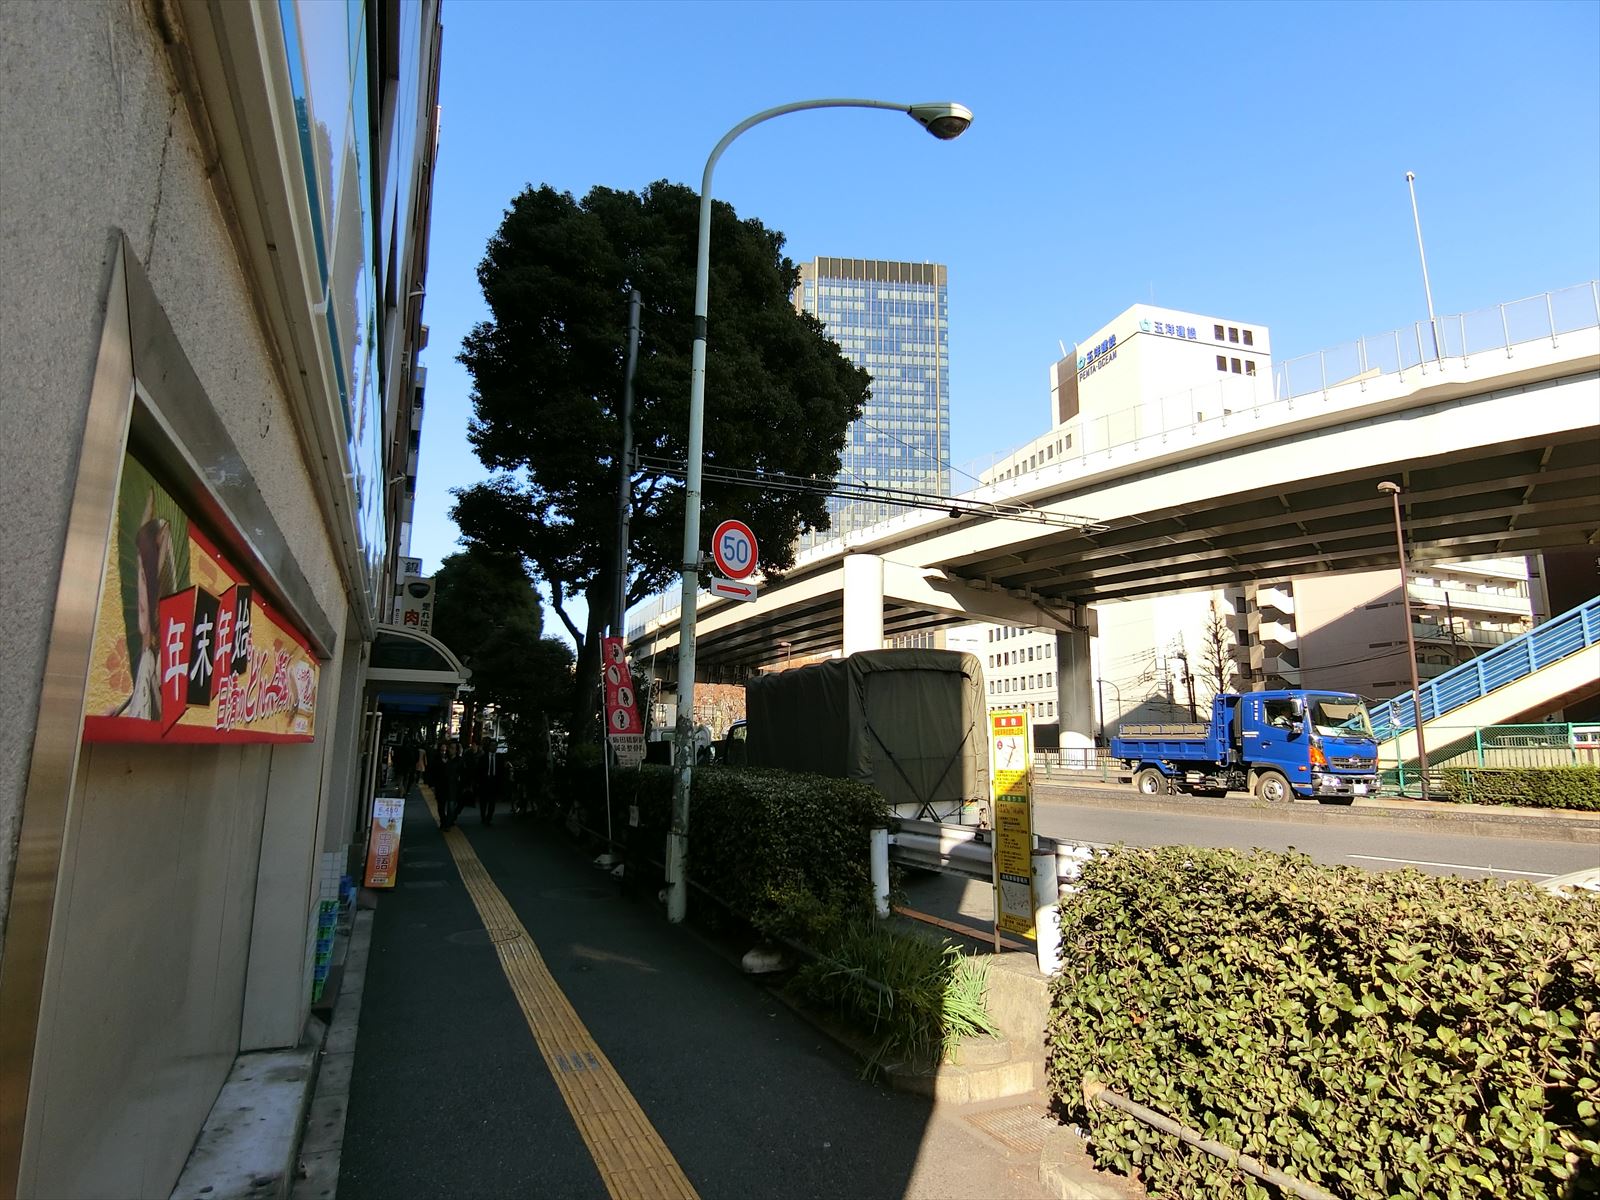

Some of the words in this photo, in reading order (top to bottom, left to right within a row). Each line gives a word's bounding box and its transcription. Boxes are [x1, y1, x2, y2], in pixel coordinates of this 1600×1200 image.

[724, 535, 748, 564] 50
[164, 598, 250, 701] 年末年始
